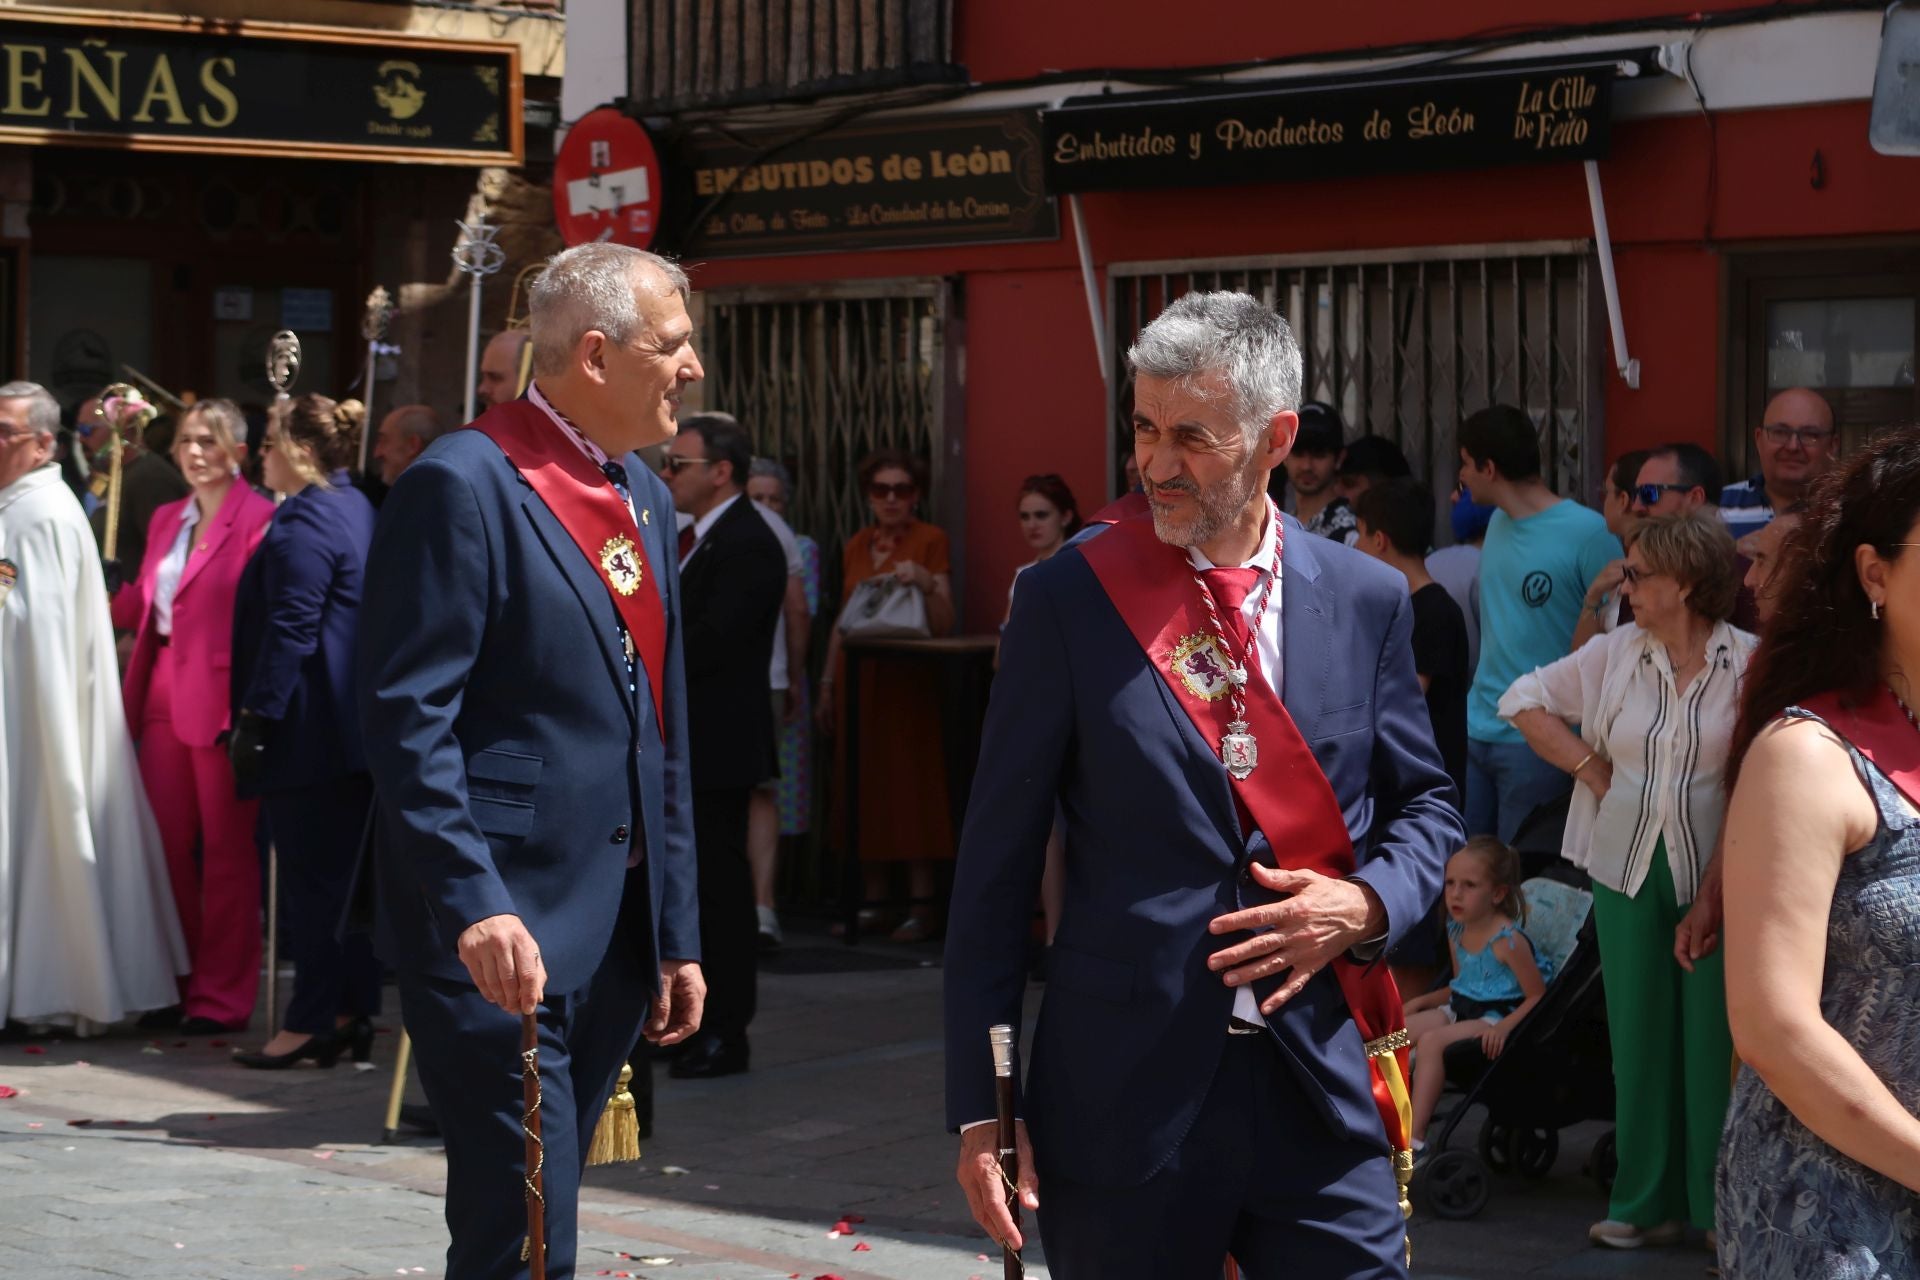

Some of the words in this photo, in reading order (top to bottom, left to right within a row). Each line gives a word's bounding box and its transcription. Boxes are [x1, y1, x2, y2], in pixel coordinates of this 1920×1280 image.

[1518, 81, 1544, 113] La
[1549, 75, 1596, 111] Cilla
[1054, 126, 1176, 164] Embutidos
[1190, 131, 1202, 160] y
[1216, 116, 1344, 151] Productos
[1363, 109, 1393, 141] de
[1407, 102, 1475, 139] León
[1514, 114, 1534, 139] De
[1536, 110, 1589, 150] Feito
[695, 155, 874, 195] EMBUTIDOS
[881, 153, 922, 182] de
[930, 144, 1012, 178] León
